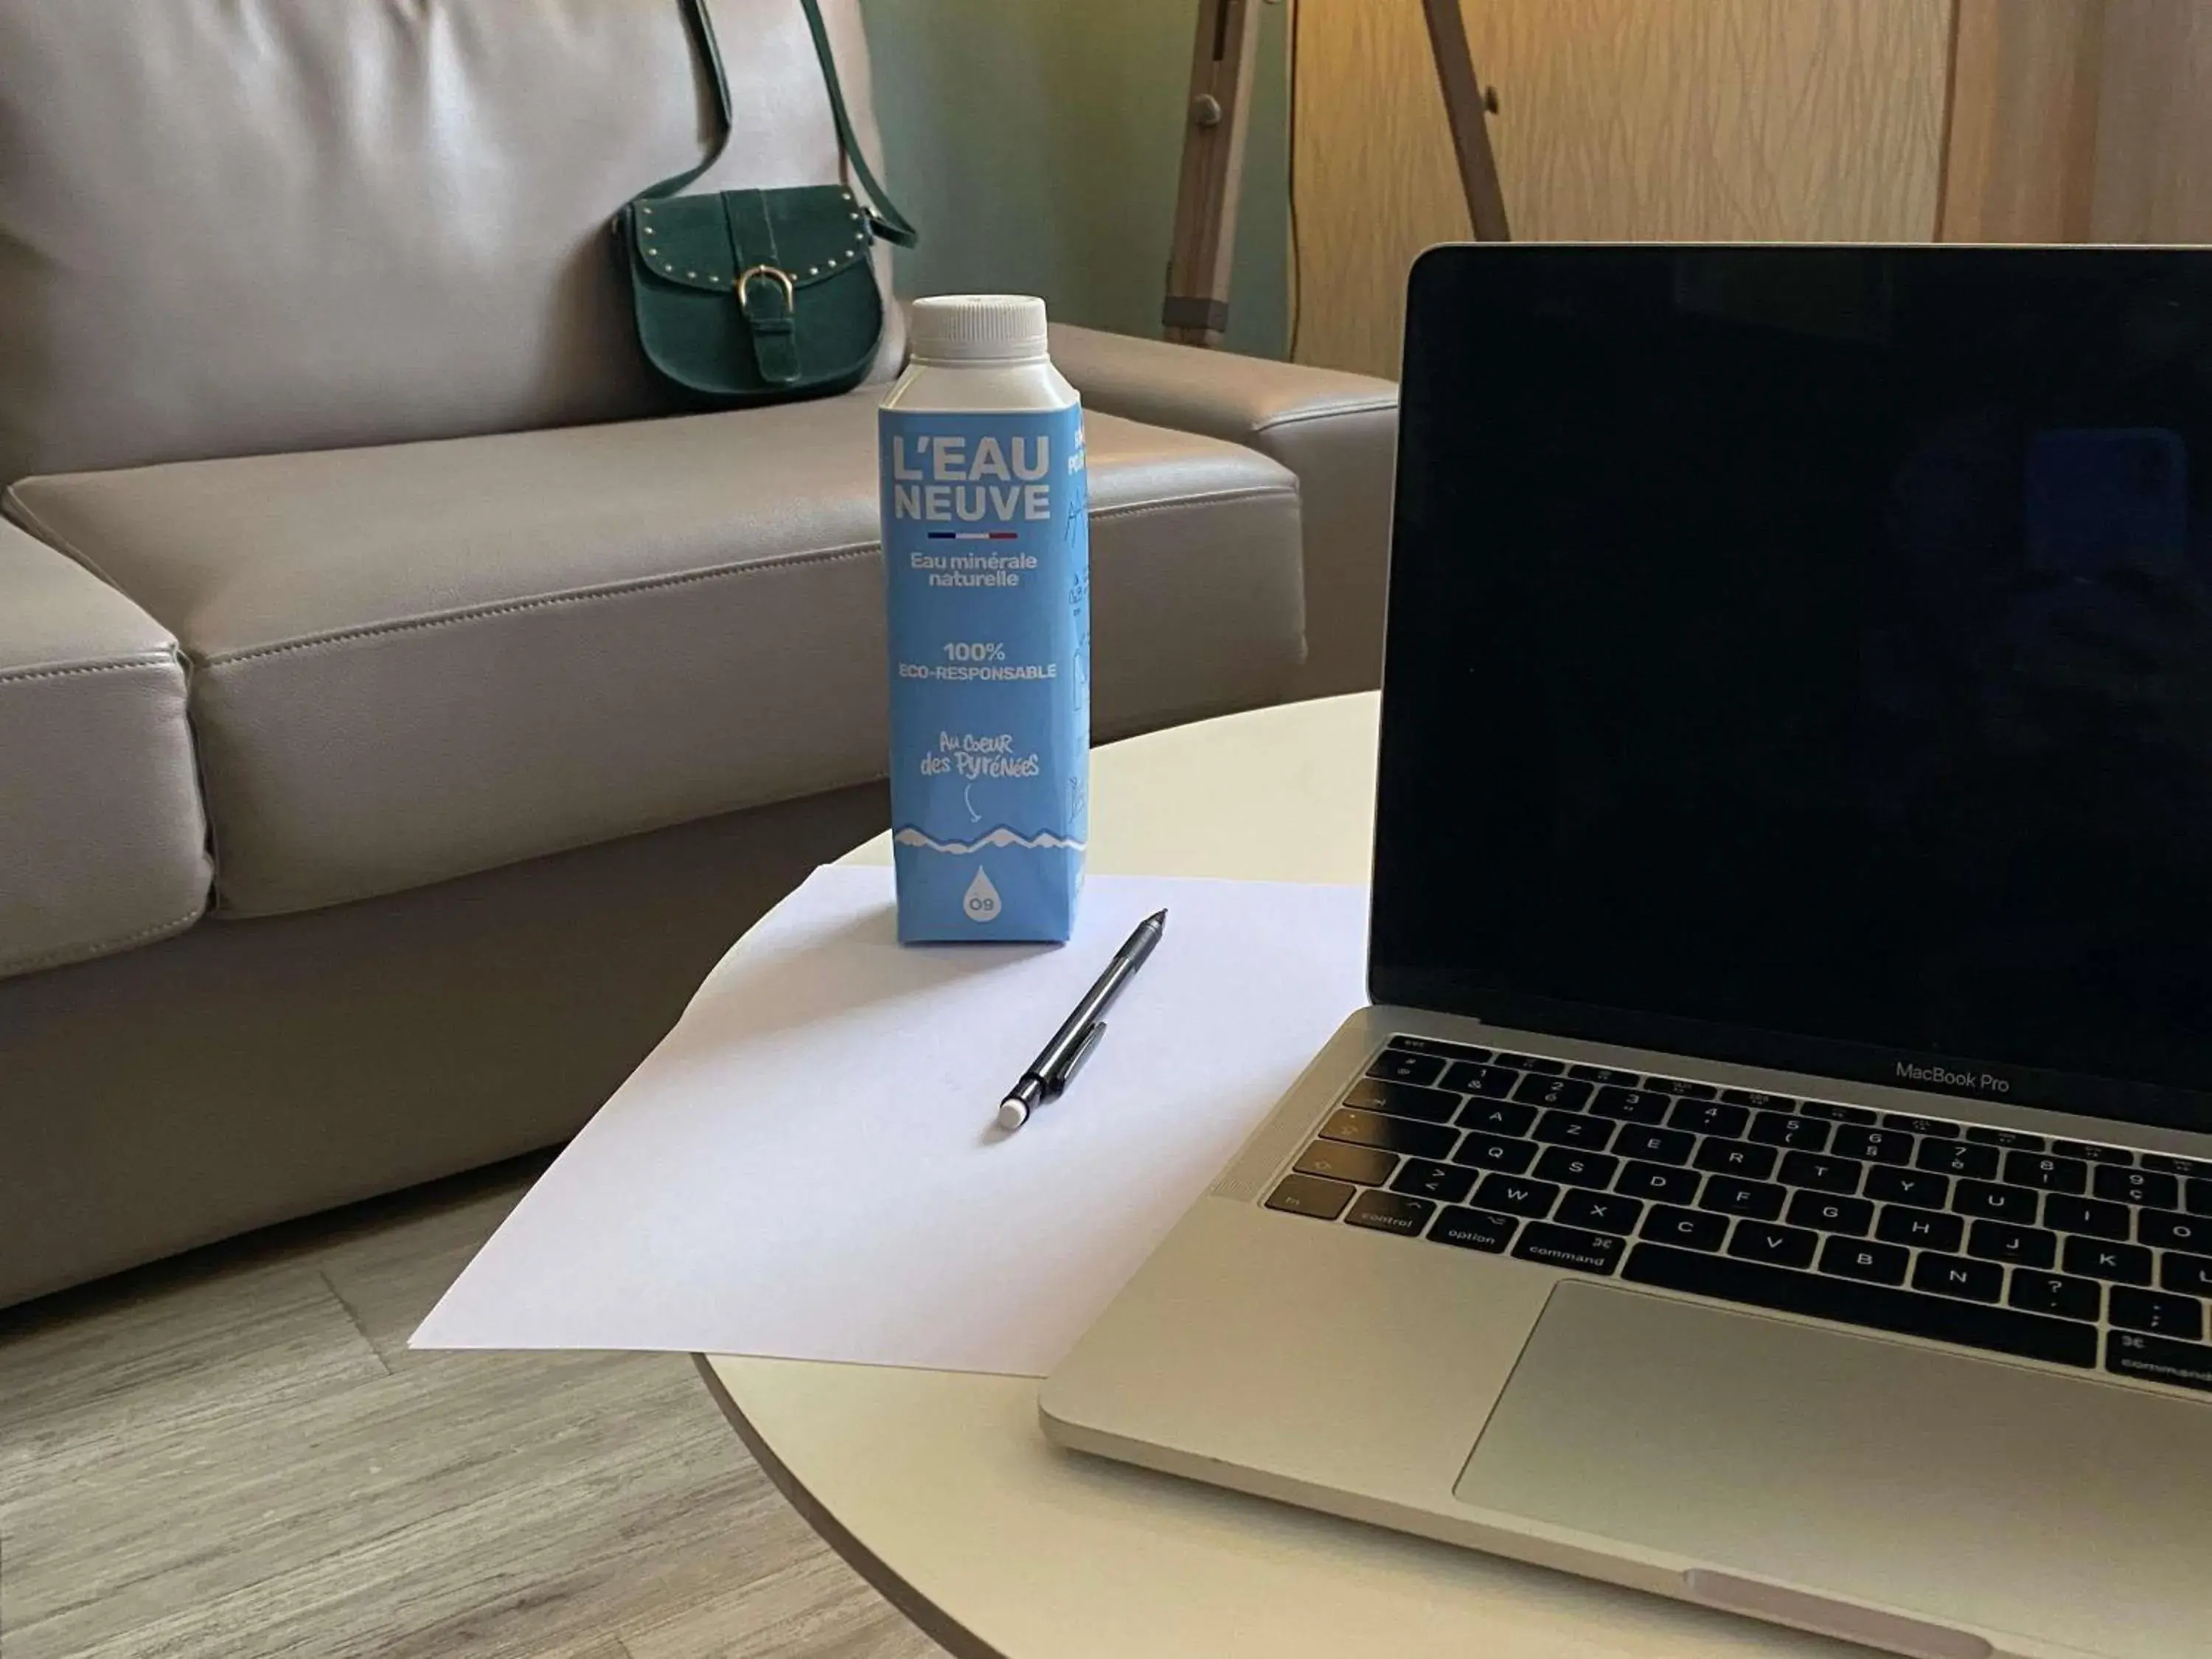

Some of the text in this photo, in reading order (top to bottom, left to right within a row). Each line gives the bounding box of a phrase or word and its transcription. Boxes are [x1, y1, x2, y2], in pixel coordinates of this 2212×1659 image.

[893, 436, 1050, 481] L'EAU
[894, 484, 1051, 521] NEUVE
[911, 552, 1038, 570] Eau minérale
[928, 571, 1020, 587] naturelle
[943, 642, 1006, 661] 100%
[898, 663, 1058, 681] ECO-RESPONSABLE
[920, 751, 952, 776] des
[969, 897, 995, 911] 09
[1896, 1061, 2010, 1093] MacBook Pro
[1551, 1081, 1565, 1091] 2
[1625, 1093, 1640, 1105] 3
[1488, 1111, 1503, 1122] A
[1704, 1107, 1718, 1117] 4
[1566, 1124, 1582, 1135] Z
[1646, 1138, 1662, 1150] E
[1487, 1146, 1504, 1159] Q
[1728, 1152, 1744, 1164] R
[1954, 1146, 1967, 1157] 7
[1568, 1161, 1585, 1173] S
[1814, 1165, 1829, 1177] T
[1649, 1175, 1667, 1187] D
[1900, 1180, 1915, 1192] Y
[2129, 1174, 2144, 1186] 9
[1506, 1187, 1528, 1201] W
[1736, 1191, 1751, 1203] F
[1988, 1194, 2005, 1206] U
[1589, 1203, 1608, 1217] X
[1822, 1206, 1839, 1218] G
[1362, 1212, 1413, 1229] control
[1677, 1220, 1694, 1234] C
[1911, 1221, 1930, 1234] H
[2172, 1225, 2192, 1238] O
[1447, 1228, 1496, 1246] option
[1766, 1236, 1783, 1249] V
[2006, 1238, 2020, 1250] J
[1528, 1241, 1606, 1267] command
[1857, 1252, 1874, 1266] B
[2099, 1253, 2118, 1267] K
[1949, 1270, 1968, 1284] N
[2199, 1269, 2212, 1283] L
[2048, 1280, 2062, 1293] ?
